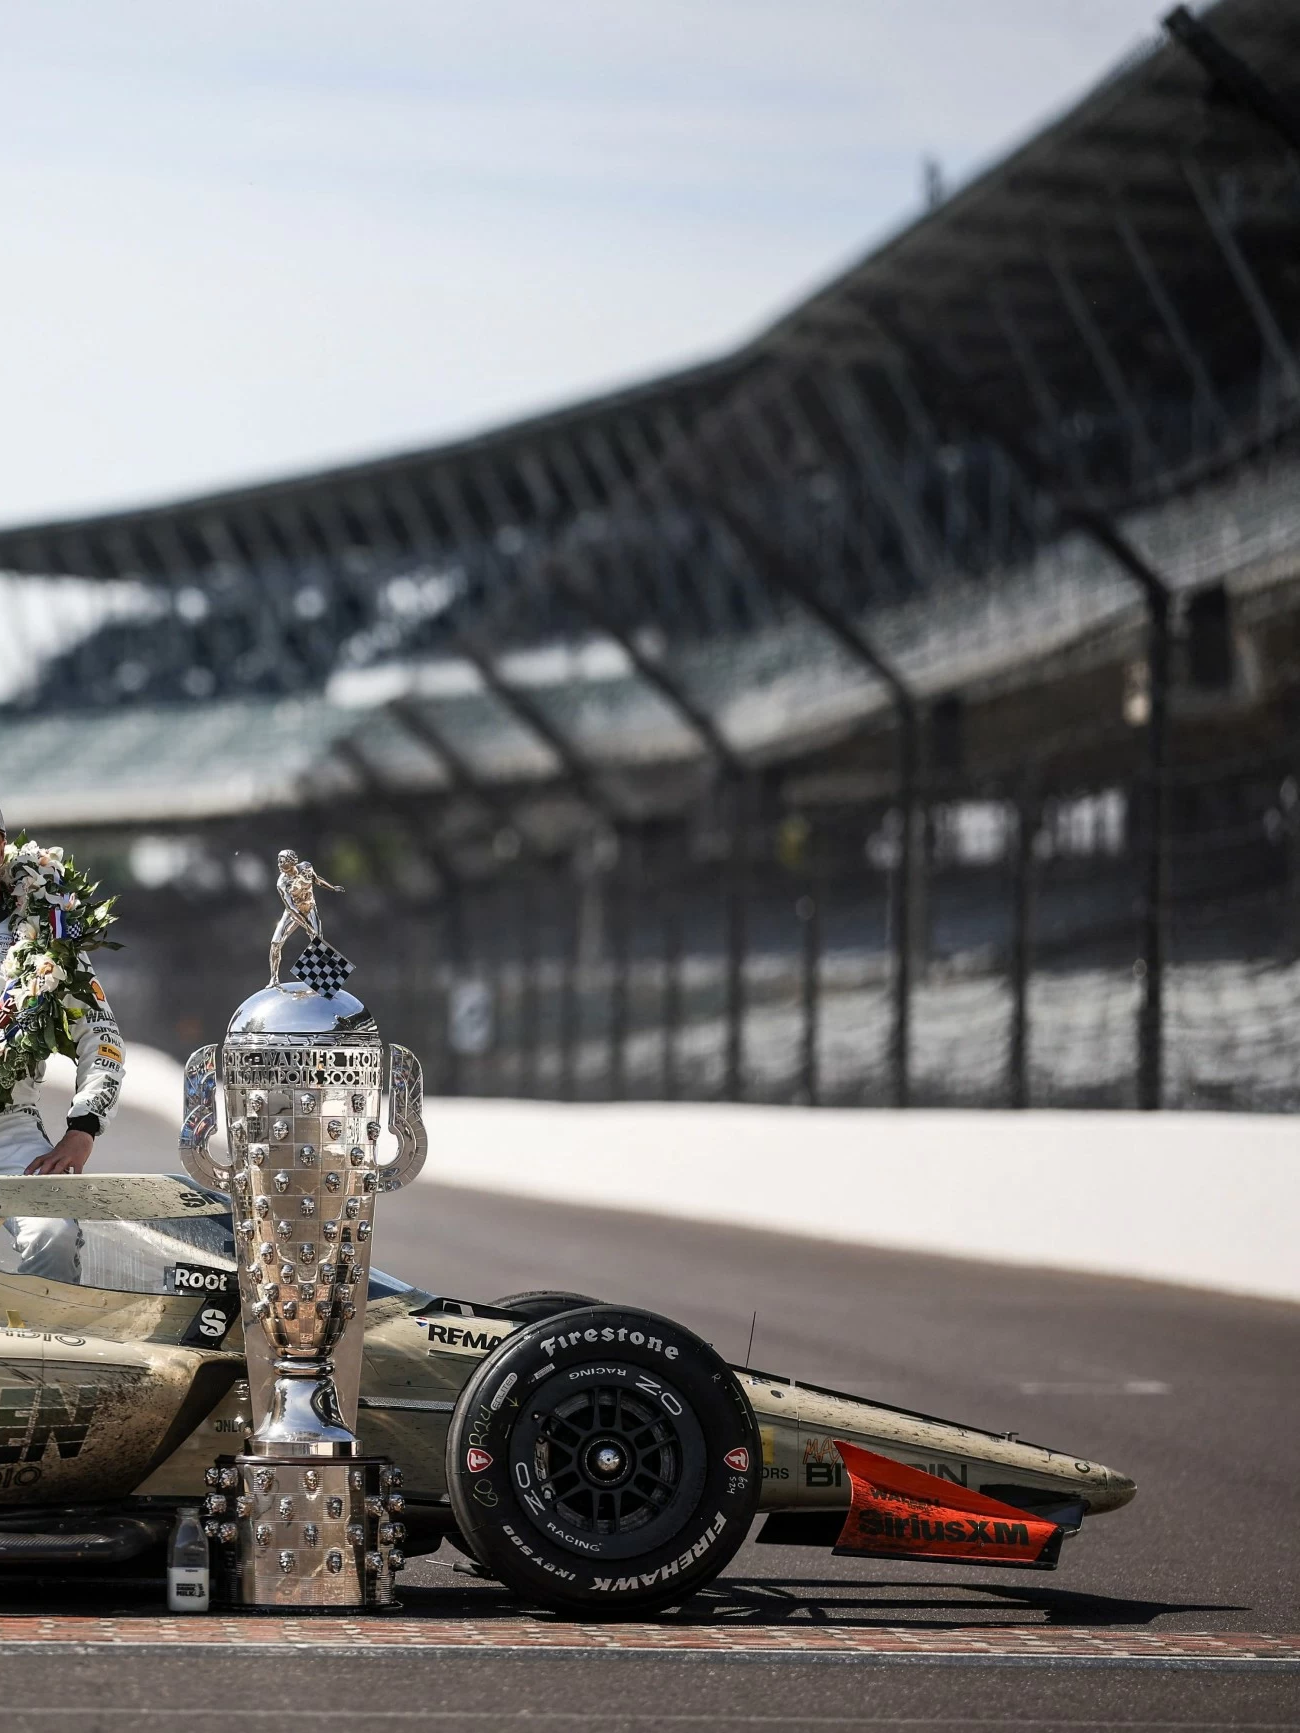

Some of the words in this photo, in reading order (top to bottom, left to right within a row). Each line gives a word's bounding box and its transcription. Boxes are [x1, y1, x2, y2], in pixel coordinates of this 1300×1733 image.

[175, 1268, 227, 1291] Root
[540, 1326, 679, 1360] Firestone
[568, 1367, 627, 1380] RACING
[547, 1522, 602, 1551] RACING
[859, 1508, 1030, 1546] SiriusXM
[589, 1511, 727, 1592] FIREHAWK
